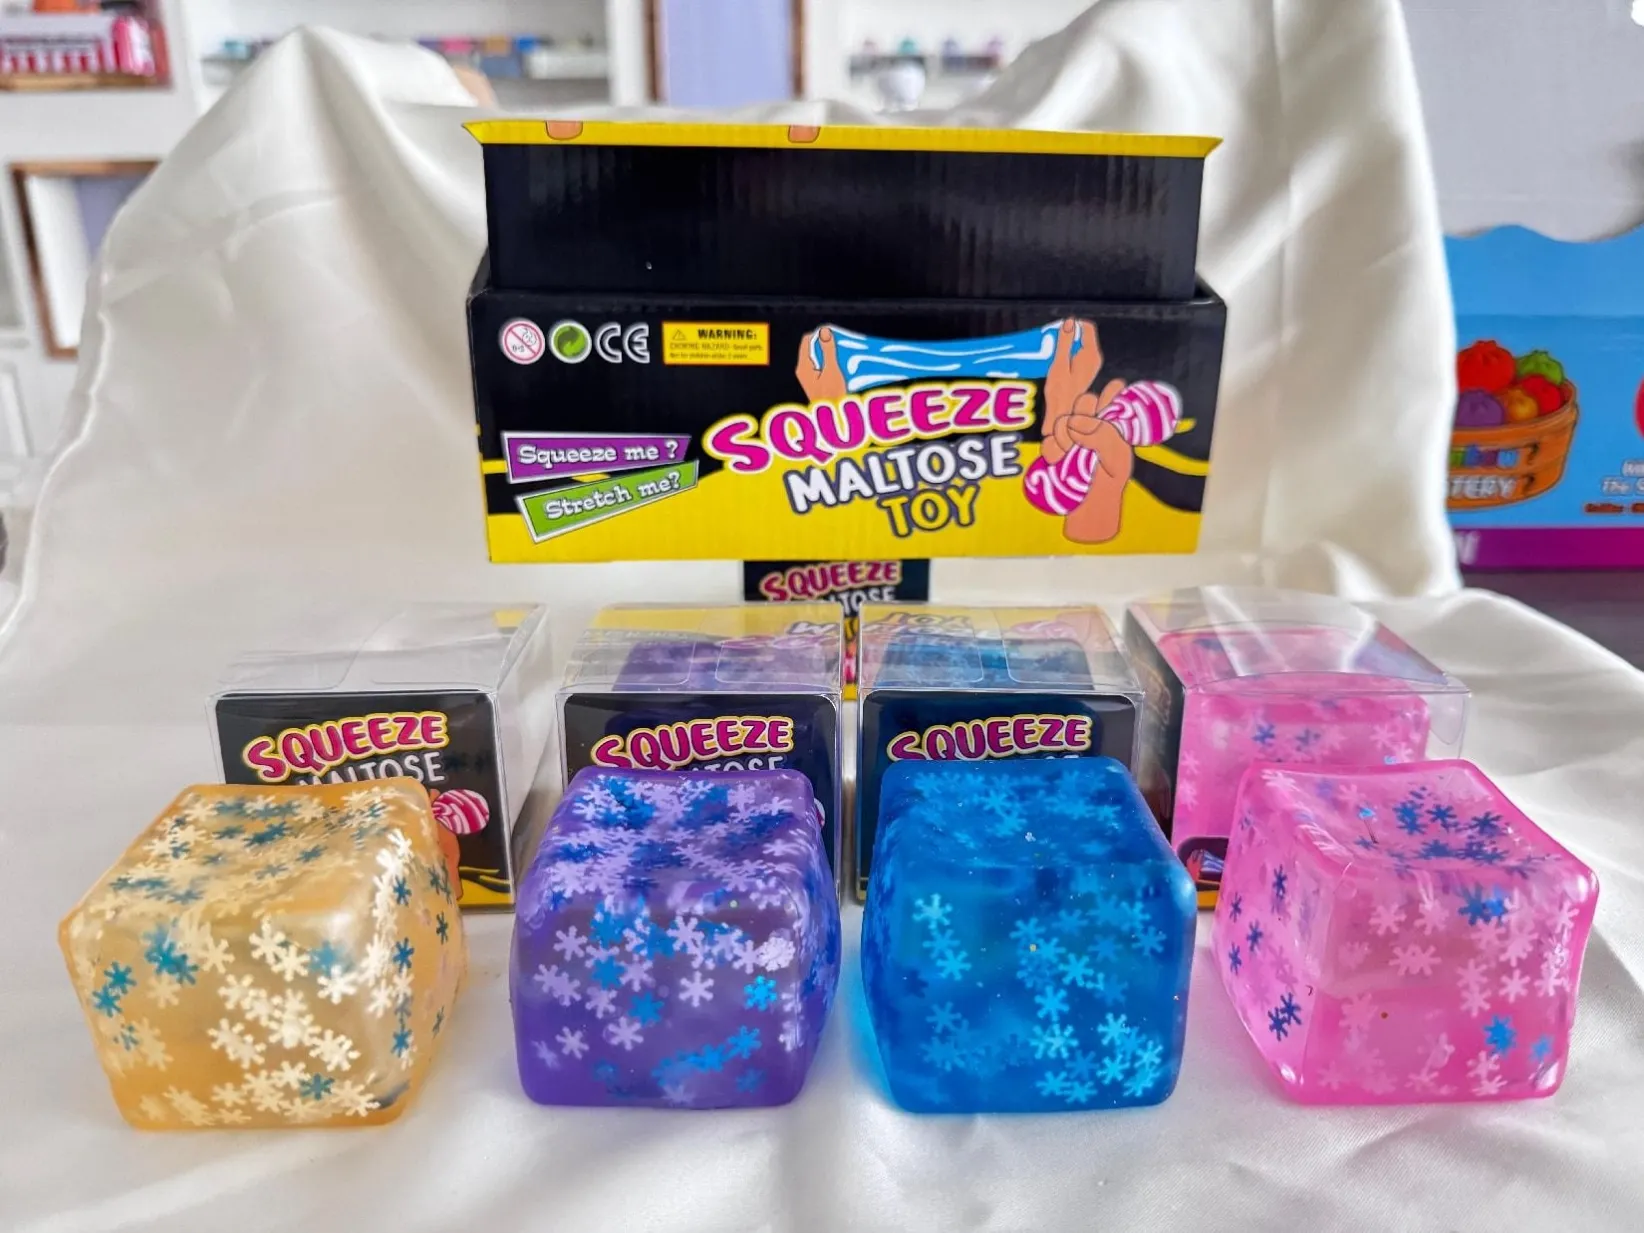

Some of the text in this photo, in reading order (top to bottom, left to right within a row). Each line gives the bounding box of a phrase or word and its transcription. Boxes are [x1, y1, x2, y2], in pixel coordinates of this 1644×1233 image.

[697, 328, 757, 340] WARNING:
[706, 382, 1032, 475] SQUEEZE
[518, 440, 679, 469] Squeeze me ?
[785, 435, 1022, 514] MALTOSE
[545, 471, 681, 519] Stretch me?
[876, 482, 979, 537] TOY
[1449, 477, 1515, 498] TERY
[762, 560, 901, 601] SQUEEZE
[244, 713, 447, 780] SQUEEZE
[592, 717, 793, 770] SQUEEZE
[888, 715, 1092, 760] SQUEEZE
